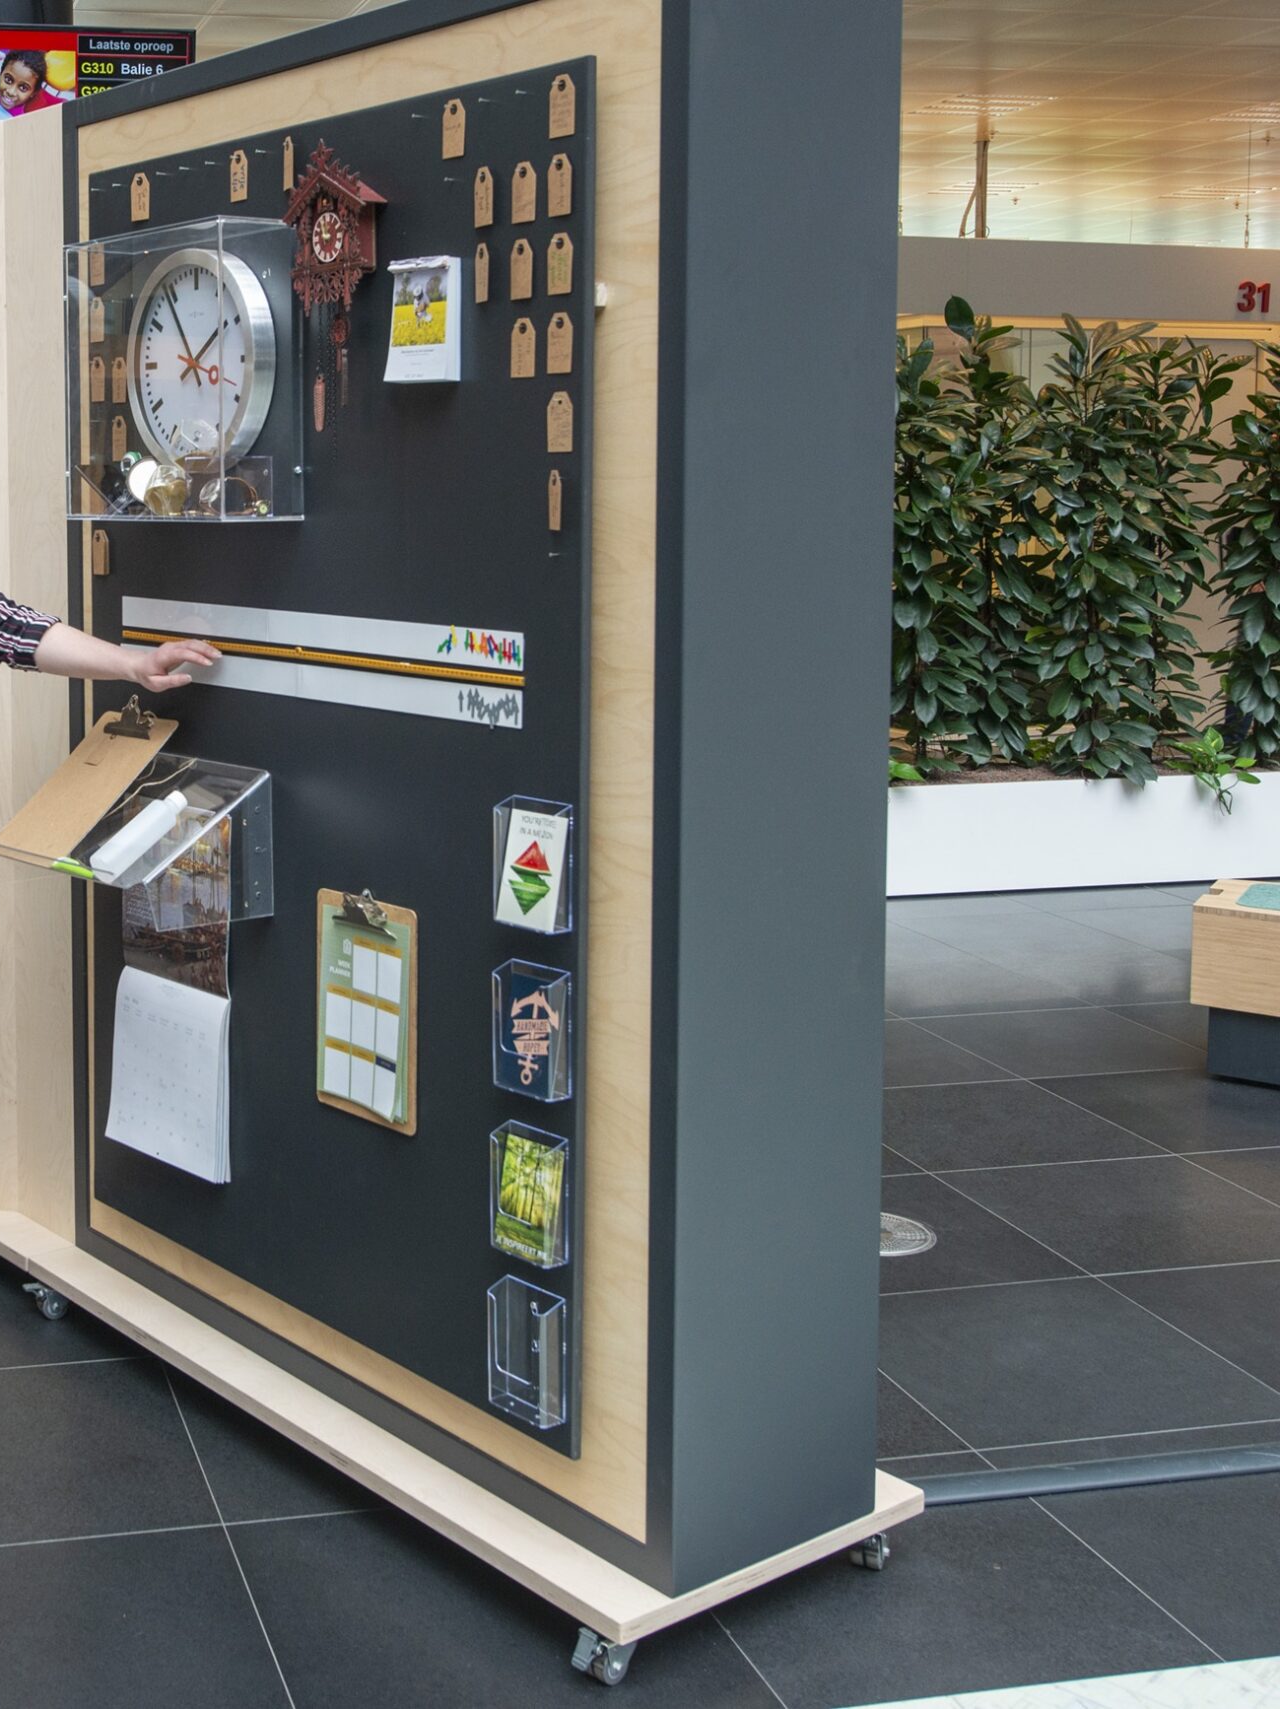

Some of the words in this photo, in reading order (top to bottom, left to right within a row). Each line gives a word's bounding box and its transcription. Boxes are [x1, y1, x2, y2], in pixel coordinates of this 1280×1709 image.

[89, 38, 130, 50] Laatste
[134, 41, 174, 54] oproep
[81, 62, 114, 74] G310
[121, 63, 153, 75] Balie
[155, 64, 164, 75] 6
[1237, 281, 1271, 313] 31
